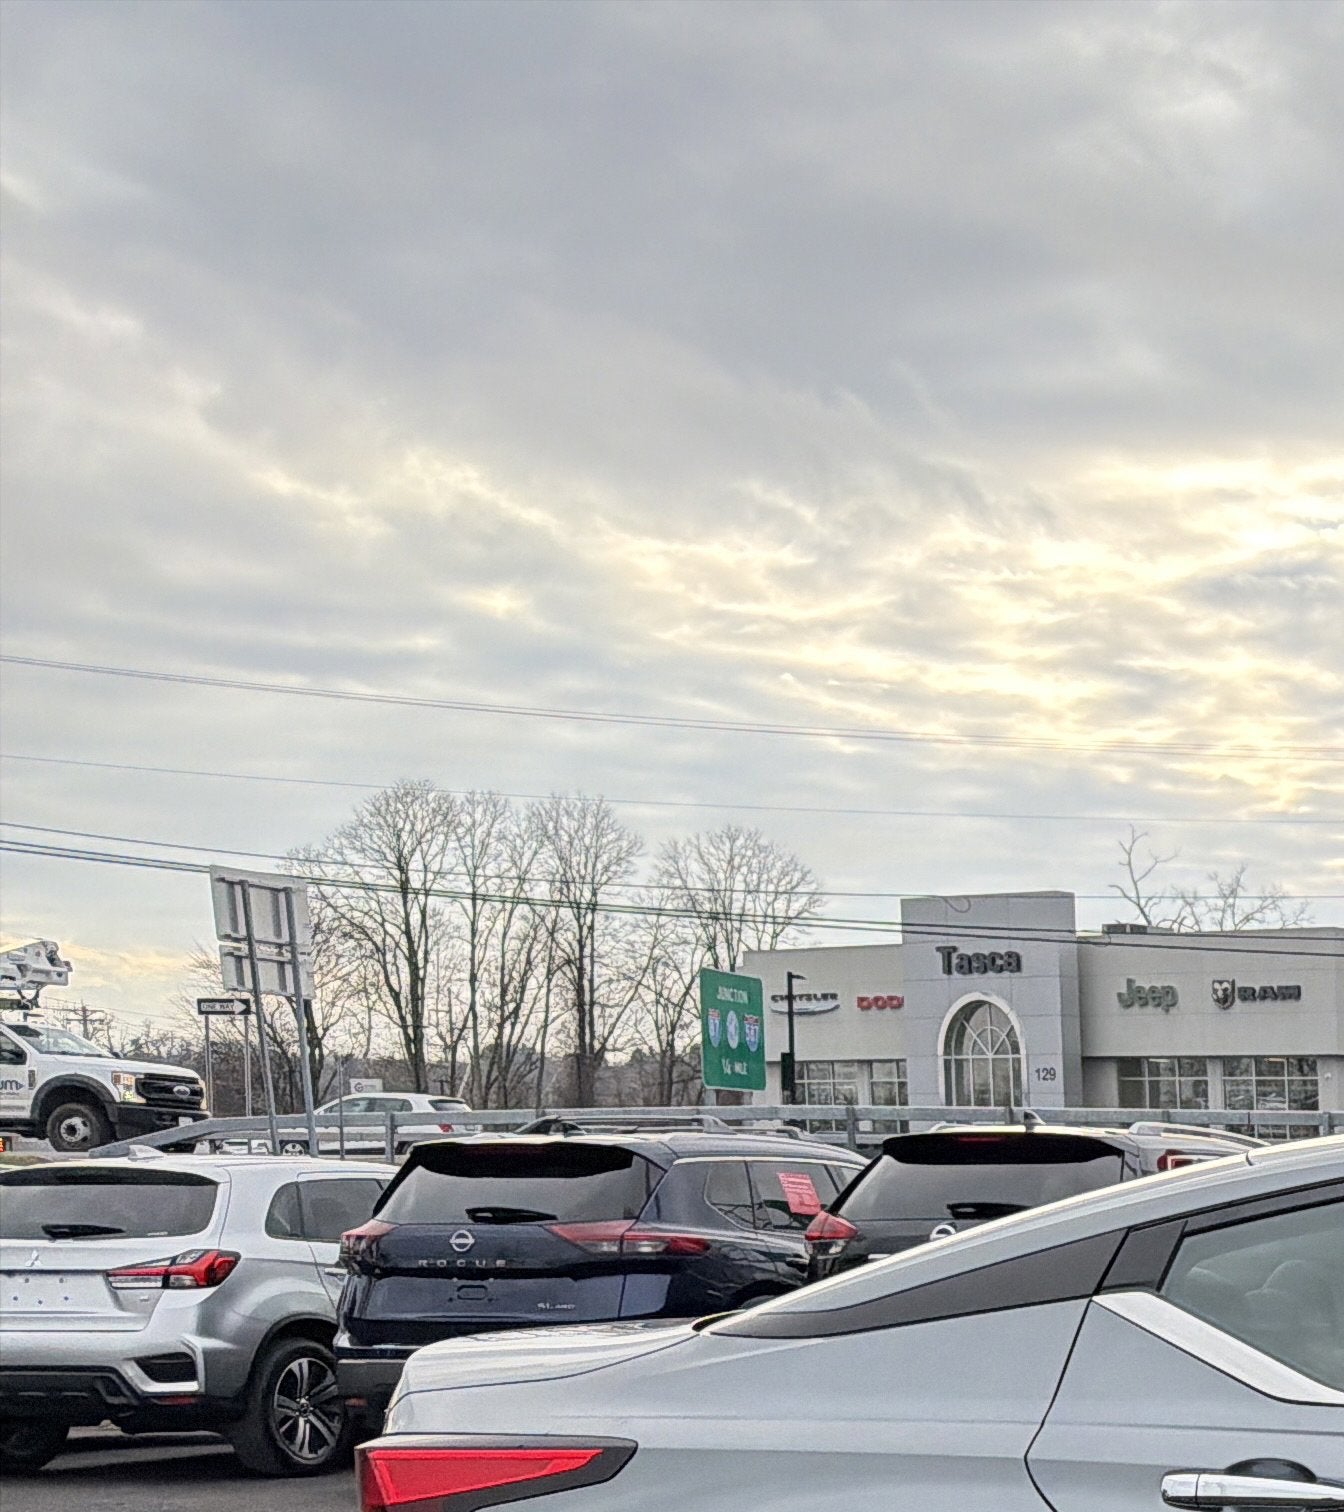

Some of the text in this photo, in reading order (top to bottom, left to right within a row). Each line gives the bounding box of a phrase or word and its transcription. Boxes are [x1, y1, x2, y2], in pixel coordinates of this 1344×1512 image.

[935, 945, 1022, 975] Tasca
[770, 992, 905, 1010] CHYSLER DOD
[1117, 978, 1302, 1015] Jeep RAM
[201, 1003, 234, 1011] ONE WAY
[1034, 1067, 1057, 1081] 129
[418, 1259, 506, 1268] ROGUE
